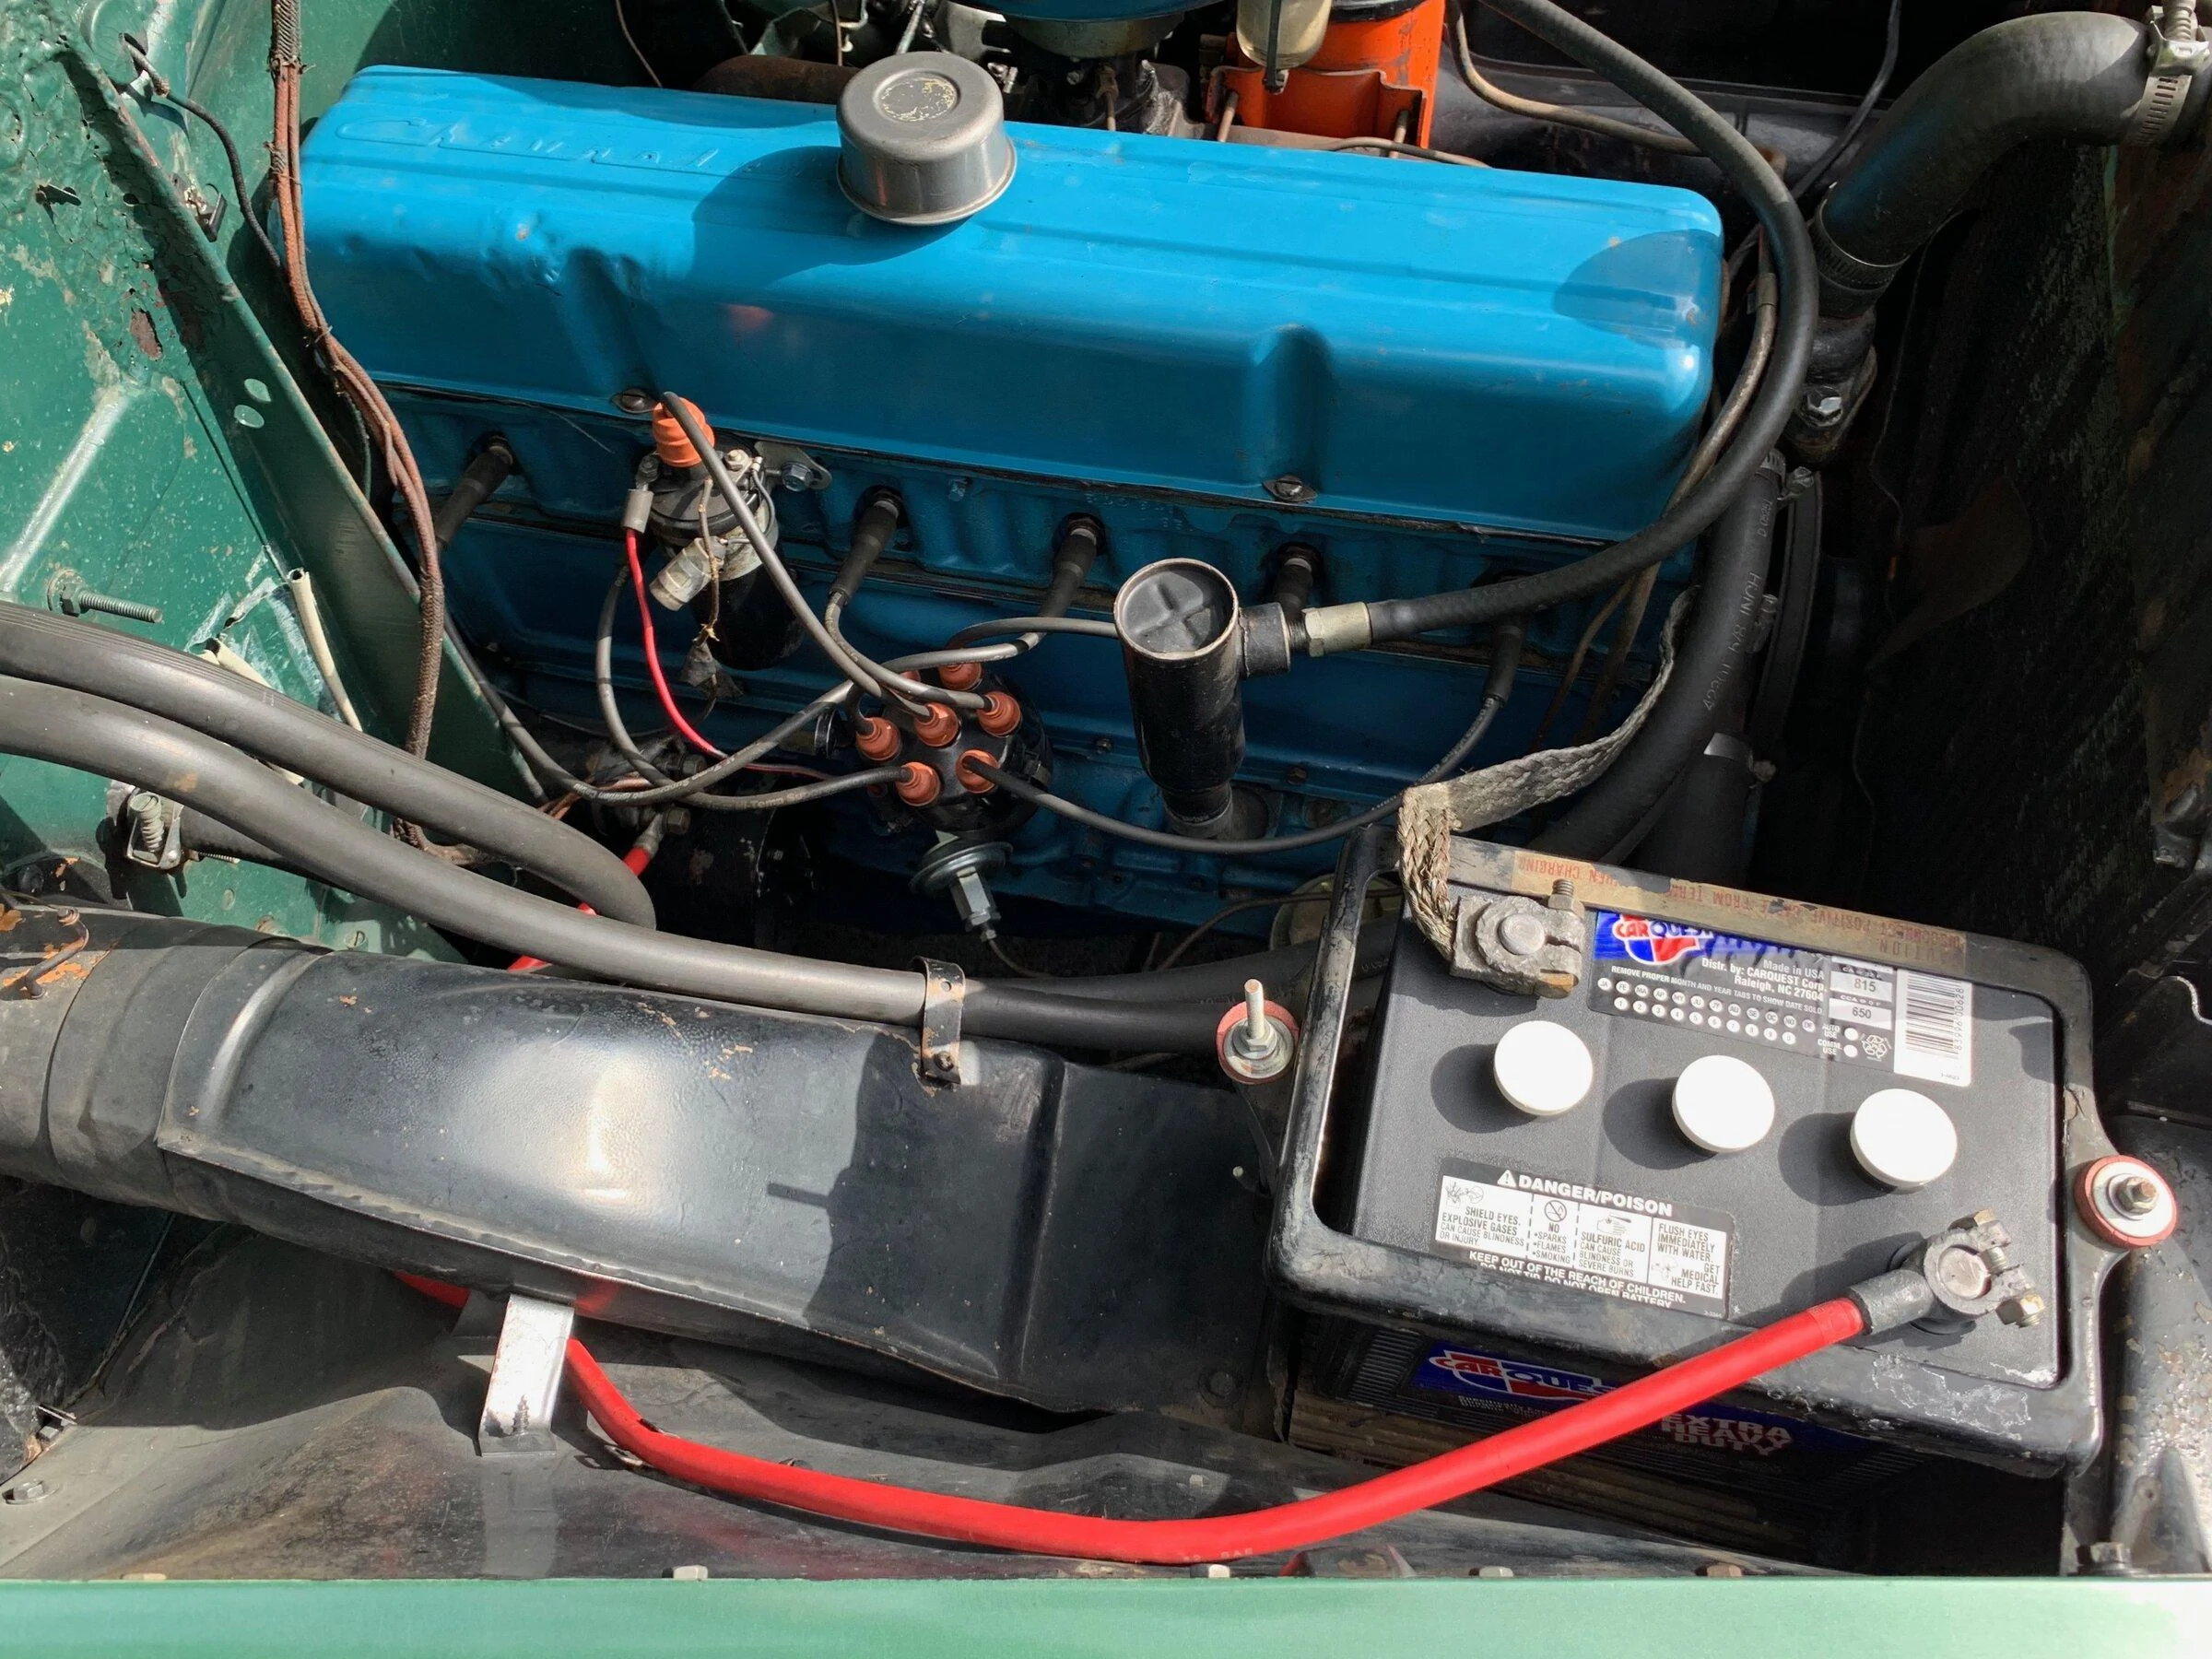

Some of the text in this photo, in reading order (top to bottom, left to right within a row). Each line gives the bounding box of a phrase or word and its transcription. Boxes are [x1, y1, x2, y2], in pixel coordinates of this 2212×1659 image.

[1739, 571, 1760, 616] INCH
[1701, 958, 1828, 993] Distr. by: CARQUEST Corp.
[1762, 959, 1825, 980] Made in USA
[1611, 965, 1823, 1015] REMOVE PROPER MONTH AND YEAR TABS TO SHOW DATE SOLD
[1777, 983, 1792, 996] NC
[1794, 987, 1824, 1002] 27604
[1854, 978, 1877, 993] 815
[1840, 994, 1859, 1003] CCA
[1852, 1006, 1872, 1019] 650
[1822, 1023, 1841, 1032] AUTO
[1824, 1030, 1838, 1039] USE
[1822, 1047, 1837, 1055] USE
[1518, 1174, 1673, 1217] DANGER/POISON
[1441, 1212, 1518, 1236] EXPLOSIVE GASES
[1465, 1206, 1521, 1226] SHIELD EYES.
[1440, 1230, 1450, 1239] OR
[1441, 1221, 1524, 1247] CAN CAUSE BLINDNESS
[1548, 1222, 1559, 1233] NO
[1659, 1223, 1709, 1241] FLUSH EYES
[1580, 1241, 1621, 1256] CAN CAUSE
[1581, 1231, 1645, 1253] SULFURIC ACID
[1657, 1233, 1715, 1253] IMMEDIATELY
[1579, 1251, 1633, 1268] BLINDNESS OR
[1657, 1242, 1713, 1263] WITH WATER.
[1579, 1259, 1606, 1272] SEVERE
[1704, 1263, 1720, 1275] GET
[1469, 1250, 1686, 1304] KEEP OUT OF THE REACH OF CHILDREN.
[1671, 1277, 1692, 1288] HELP
[1681, 1268, 1719, 1285] MEDICAL
[1662, 1421, 1792, 1449] HEAVY
[1664, 1413, 1793, 1441] EXTRA
[1675, 1431, 1776, 1457] DUTY
